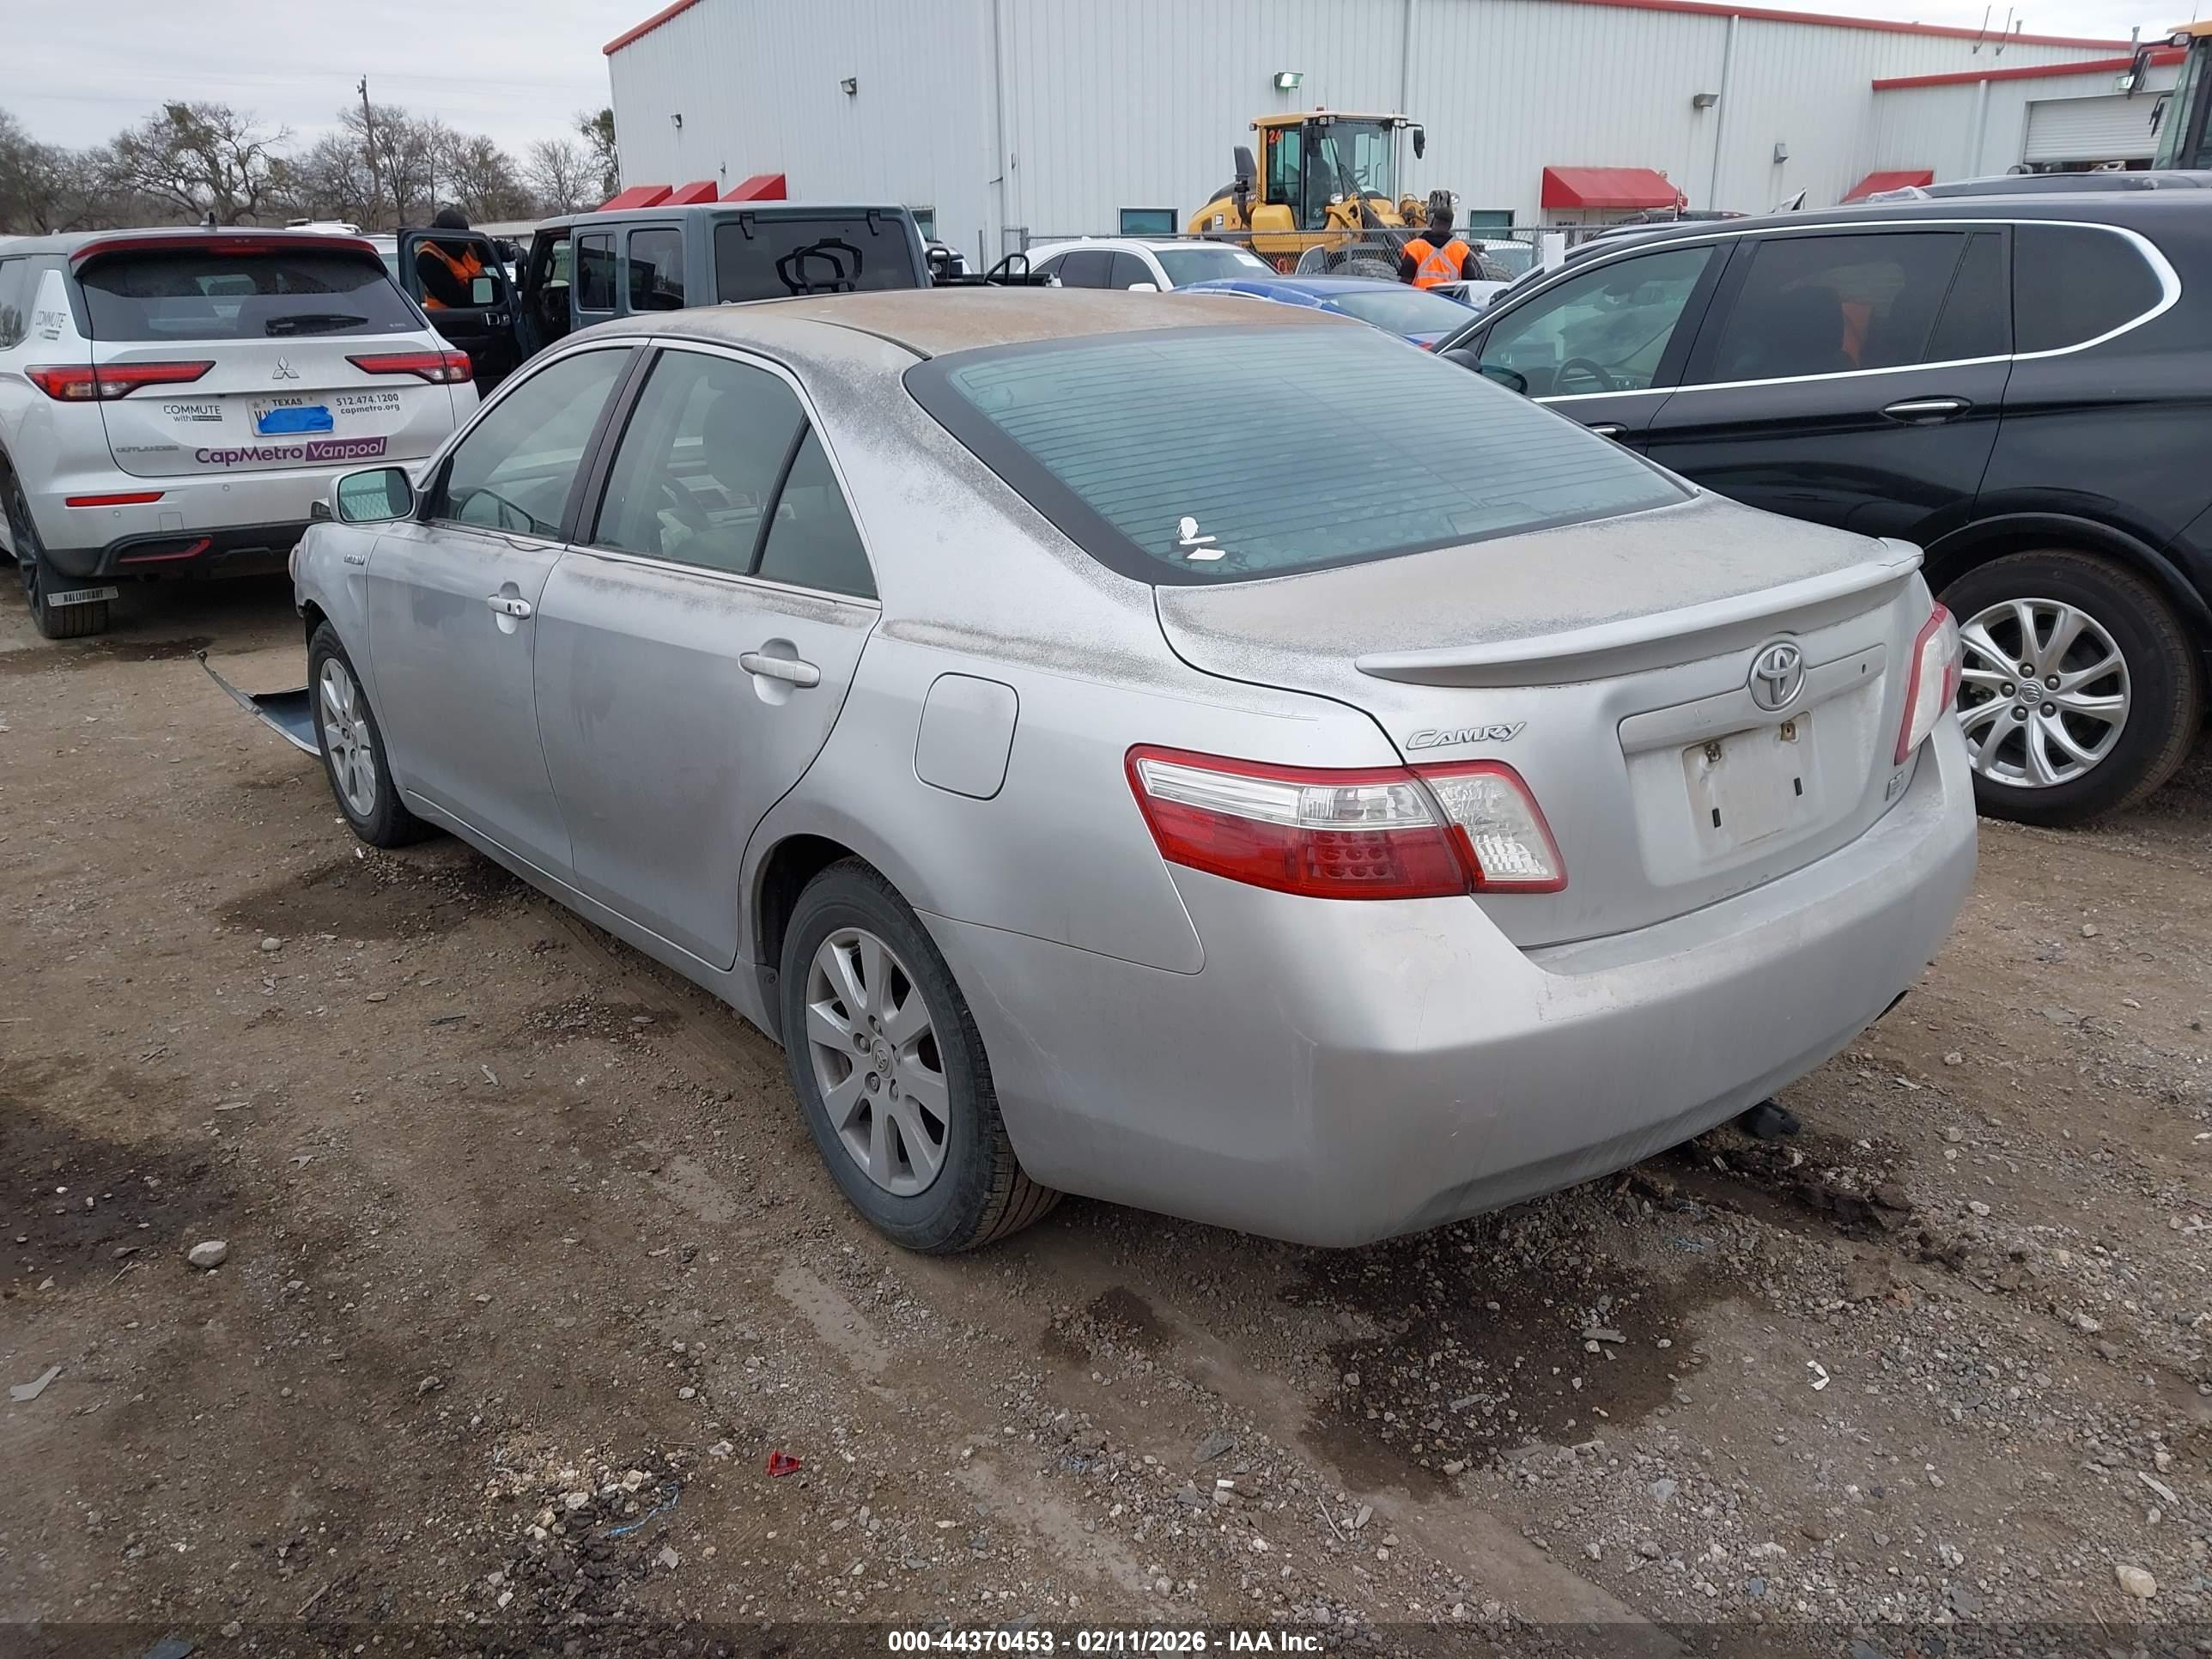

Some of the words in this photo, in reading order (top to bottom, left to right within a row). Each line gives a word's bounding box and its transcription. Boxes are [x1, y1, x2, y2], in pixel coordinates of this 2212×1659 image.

[272, 398, 303, 407] TEXAS
[337, 393, 399, 406] 512.474.1200
[163, 404, 222, 415] COMMUTE
[340, 403, 400, 415] capmetro.org
[173, 414, 192, 422] with
[195, 445, 304, 467] CapMetro
[310, 438, 385, 459] Vanpool
[1406, 721, 1527, 751] CAMRY
